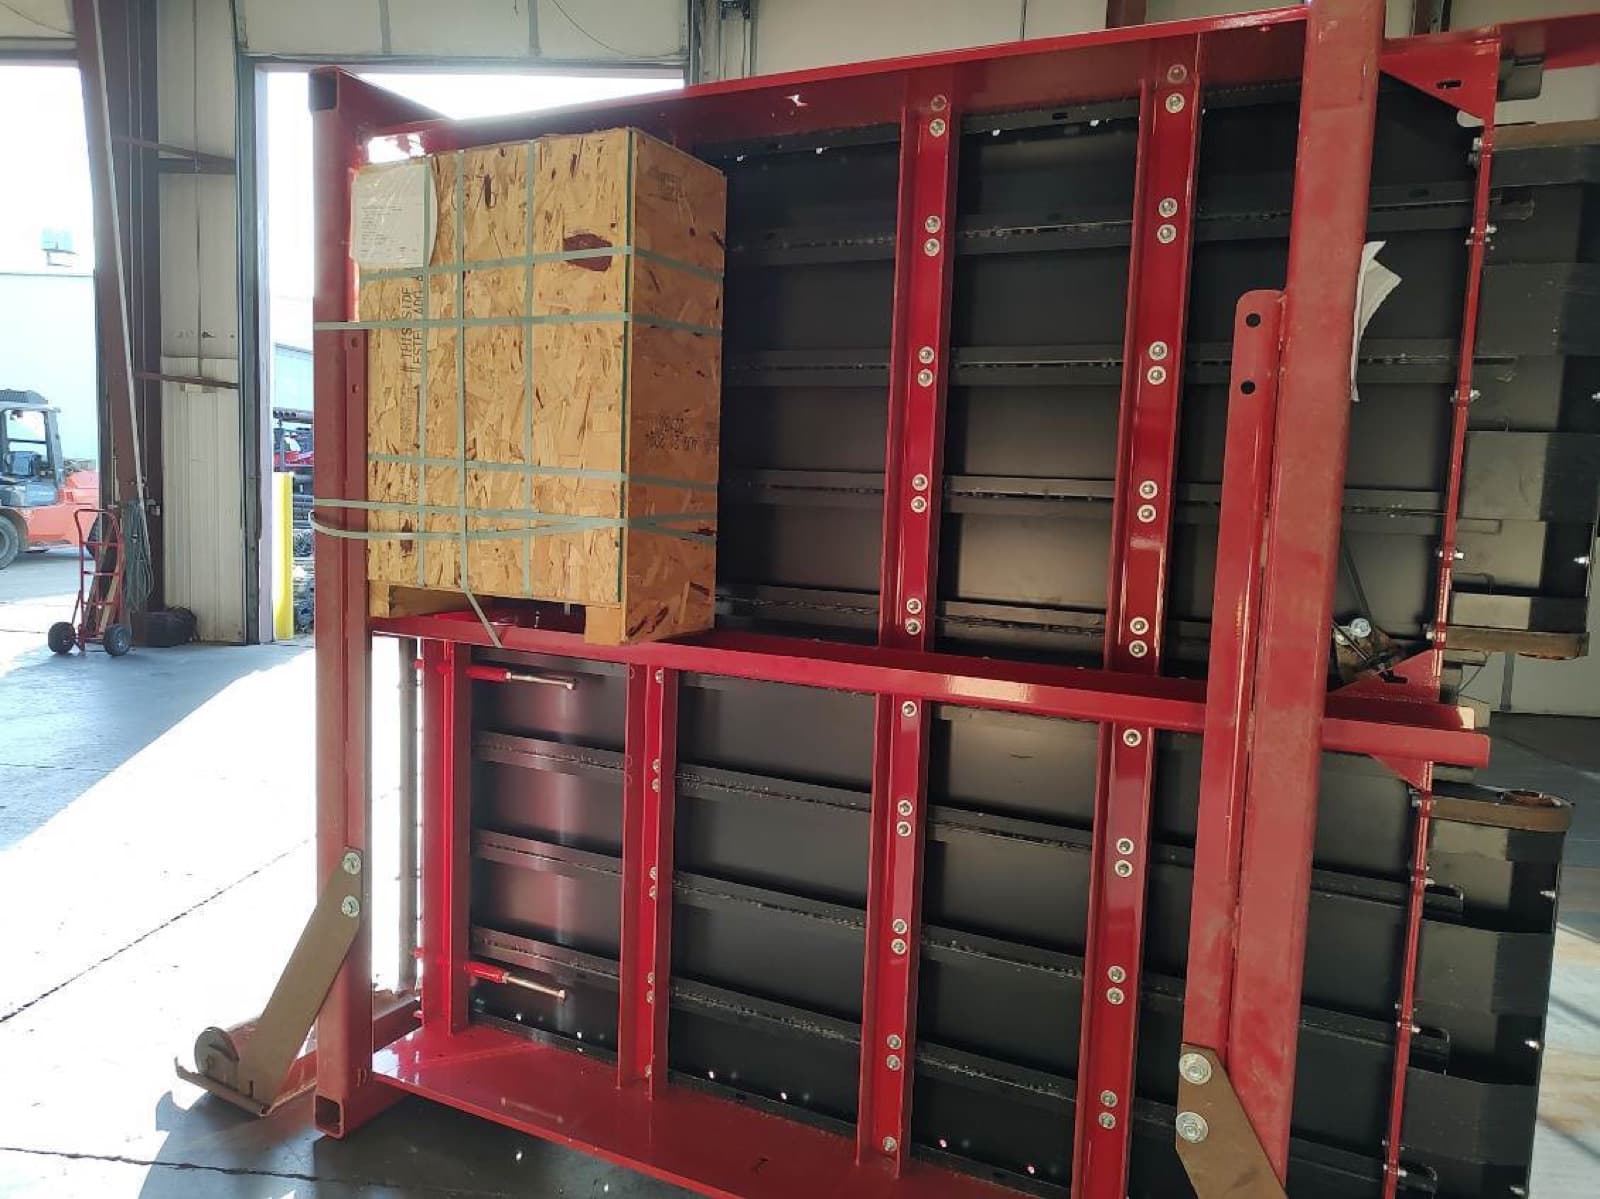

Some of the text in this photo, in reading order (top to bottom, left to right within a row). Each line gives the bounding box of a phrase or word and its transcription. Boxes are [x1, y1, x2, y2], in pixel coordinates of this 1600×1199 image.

[401, 287, 413, 359] THIS SIDE
[413, 290, 424, 317] ADO
